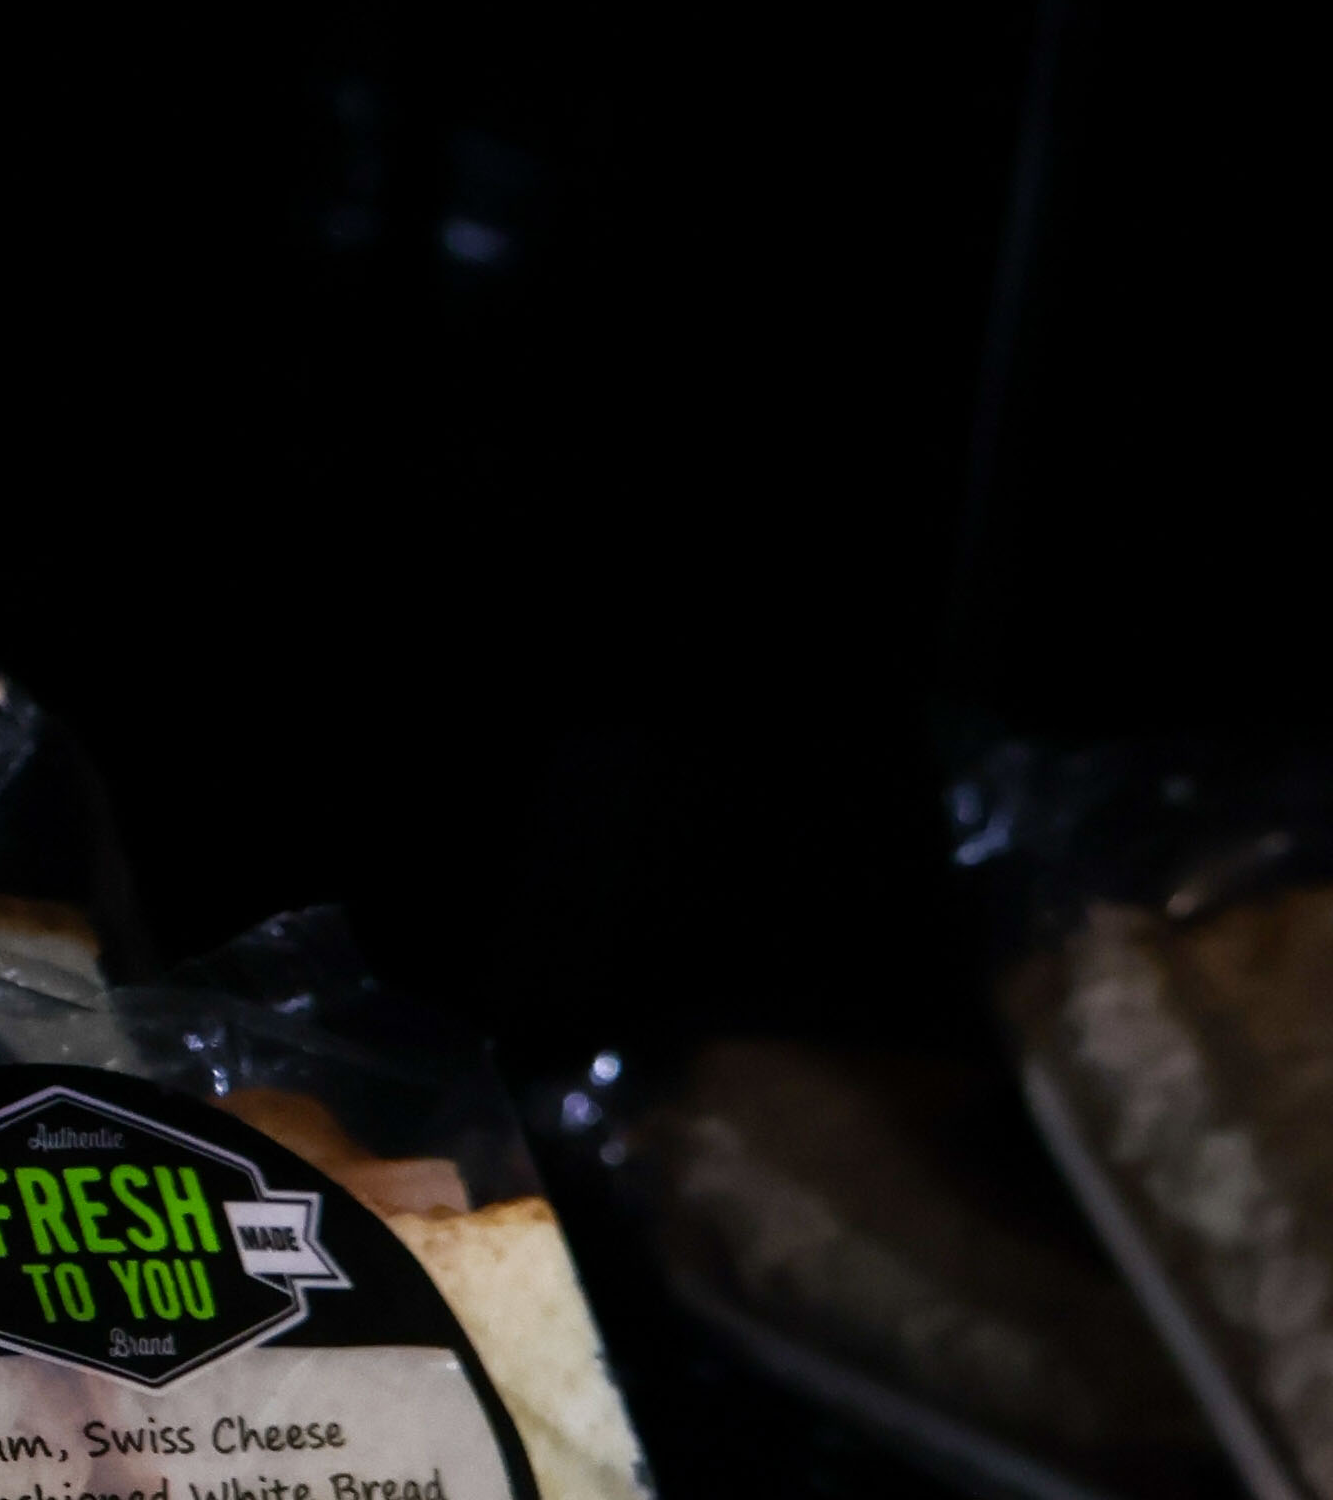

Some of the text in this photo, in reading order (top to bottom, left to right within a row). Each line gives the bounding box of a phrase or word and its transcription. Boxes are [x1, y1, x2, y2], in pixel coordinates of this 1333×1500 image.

[27, 1121, 125, 1153] Authentic
[237, 1225, 301, 1253] MADE
[20, 1256, 217, 1324] TO YOU
[108, 1327, 177, 1359] Brand
[83, 1418, 196, 1458] Swiss
[212, 1416, 347, 1455] Cheese
